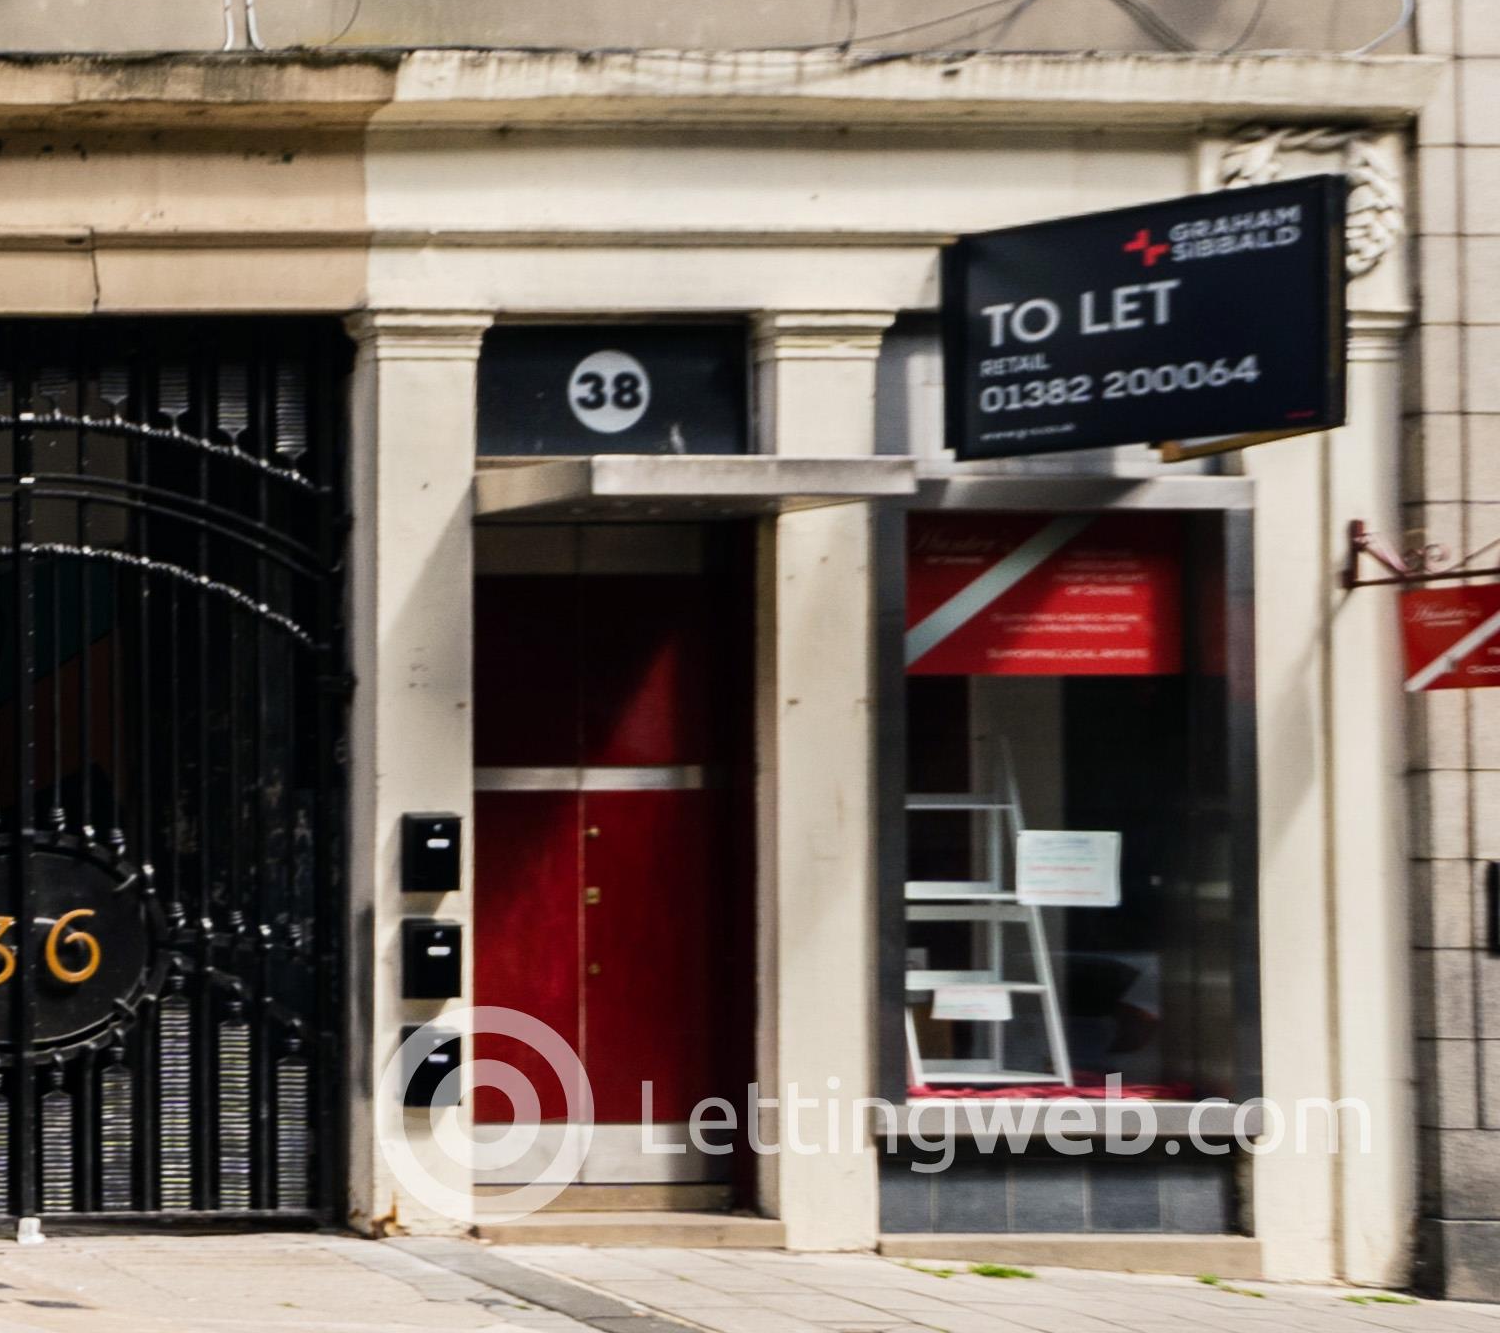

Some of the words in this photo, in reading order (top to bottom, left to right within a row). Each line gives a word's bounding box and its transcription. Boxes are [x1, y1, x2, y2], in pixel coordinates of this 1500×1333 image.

[1169, 205, 1302, 243] GRAHAM
[1172, 226, 1302, 262] SIBBALD
[981, 298, 1061, 347] TO
[1080, 279, 1181, 334] LET
[980, 352, 1049, 377] RETAIL
[980, 375, 1092, 413] 01382
[1102, 354, 1260, 398] 200064
[576, 371, 642, 411] 38
